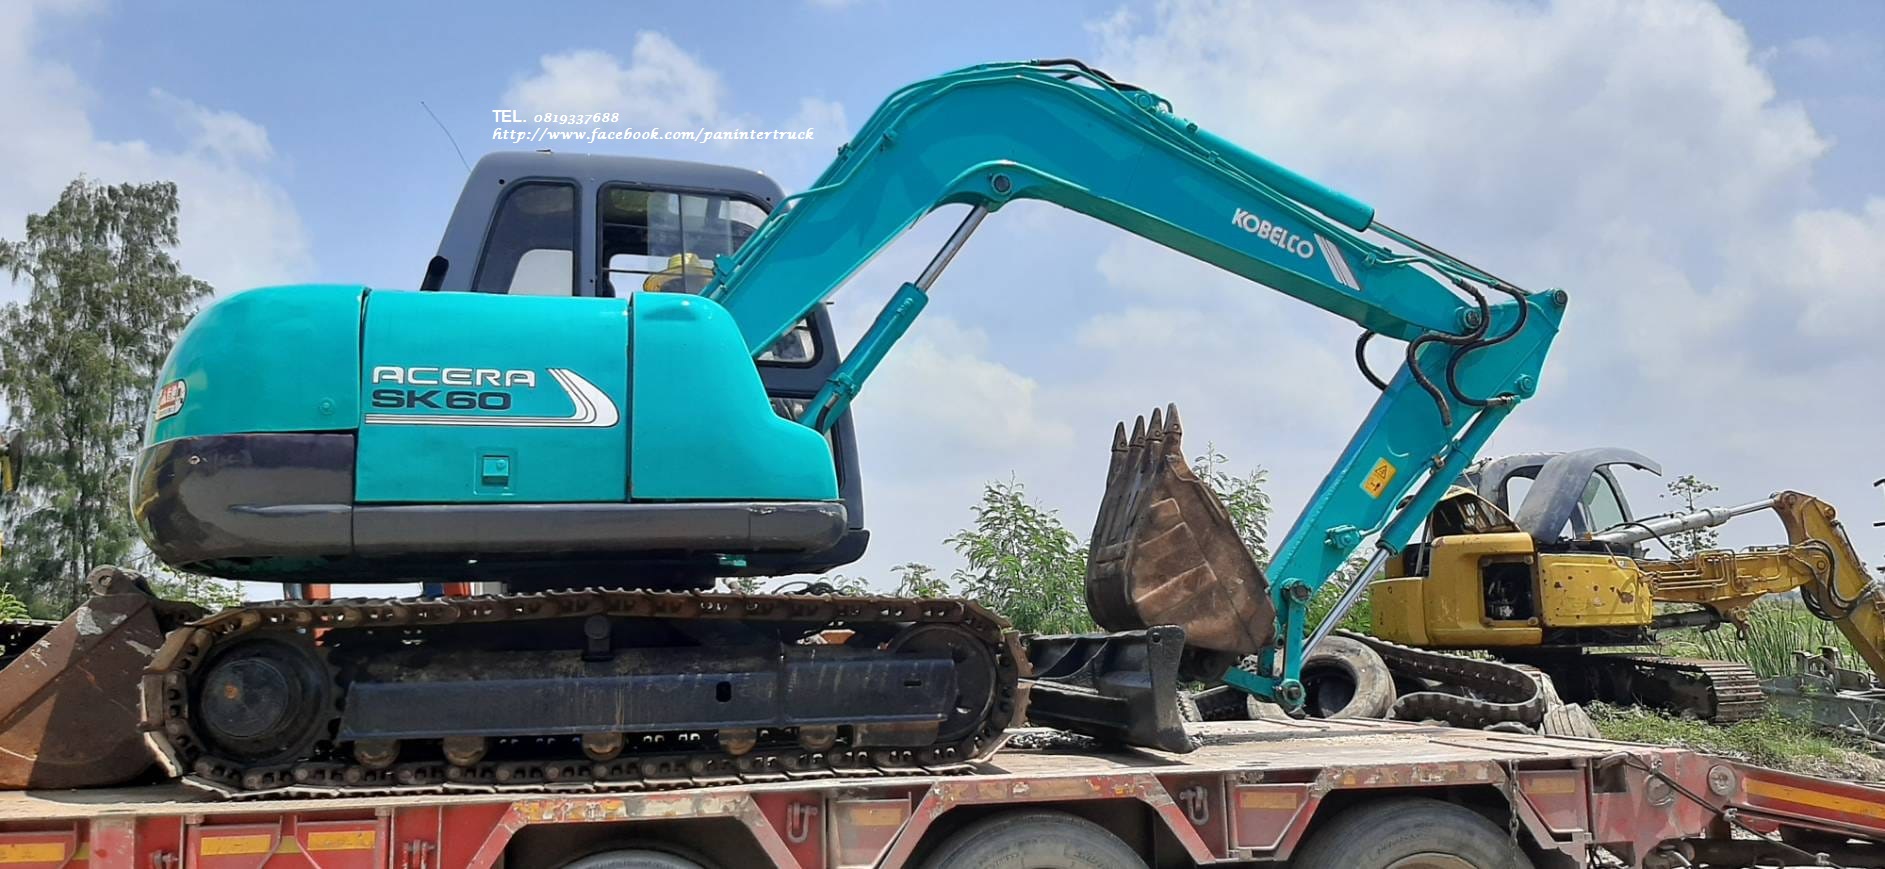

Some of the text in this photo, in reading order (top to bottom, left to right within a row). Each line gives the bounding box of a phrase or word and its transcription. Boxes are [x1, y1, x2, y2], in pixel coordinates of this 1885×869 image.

[1231, 207, 1314, 259] KOBELCO
[372, 366, 537, 388] ACERA
[371, 389, 512, 410] SK60
